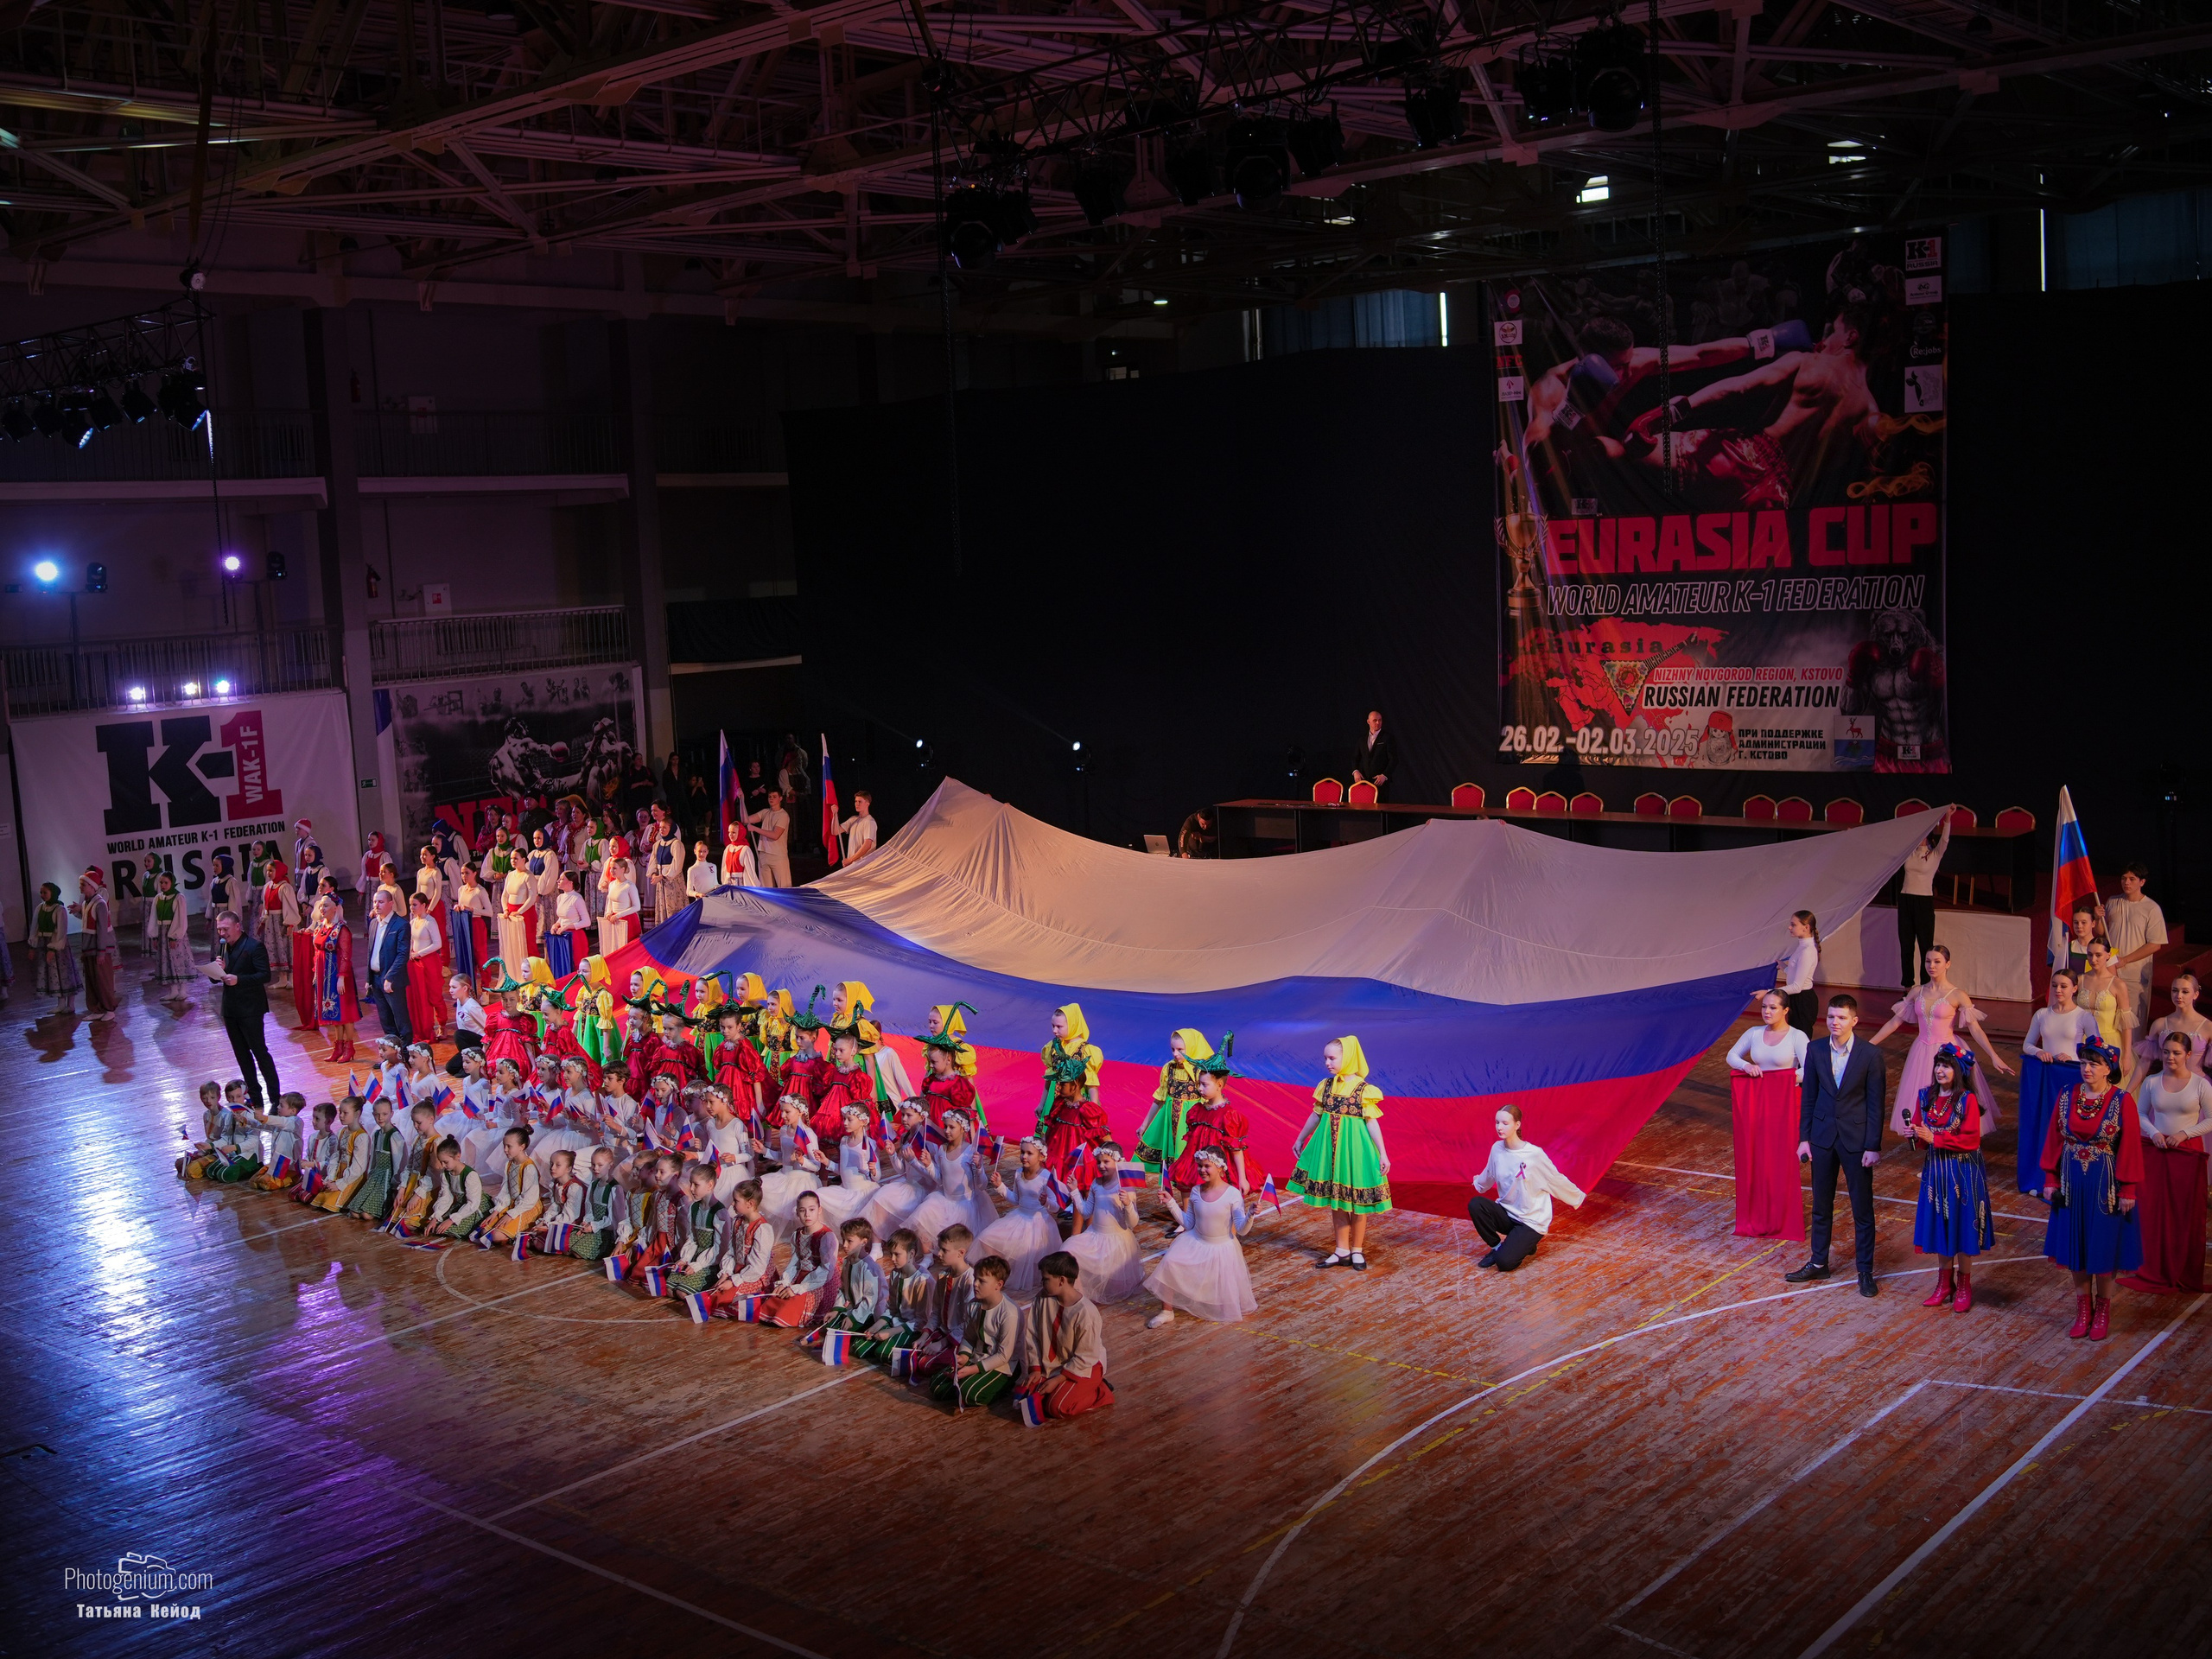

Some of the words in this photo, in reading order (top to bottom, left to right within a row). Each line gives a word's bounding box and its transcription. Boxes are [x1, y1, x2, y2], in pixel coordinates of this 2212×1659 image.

[1907, 239, 1937, 259] K-1
[1906, 260, 1938, 269] RUSSIA
[1547, 510, 1792, 575] EURASIA
[1808, 503, 1937, 567] CUP
[1548, 584, 1621, 616] WORLD
[1621, 581, 1732, 614] AMATEUR
[1732, 579, 1775, 613] K-1
[1776, 575, 1926, 612] FEDERATION
[1655, 668, 1694, 681] NIZHNY
[1695, 668, 1753, 681] NOVGOROD
[1755, 668, 1797, 683] REGION,
[1800, 668, 1843, 681] KSTOVO
[1644, 686, 1721, 707] RUSSIAN
[1726, 685, 1840, 708] FEDERATION
[1738, 729, 1758, 738] ПРИ
[1761, 729, 1823, 739] ПОДДЕРЖКЕ
[1738, 740, 1826, 750] АДМИНИСТРАЦИИ
[1750, 751, 1788, 760] КСТОВО
[95, 710, 284, 836] K-1
[239, 725, 264, 804] WAK-1F
[107, 838, 145, 855] WORLD
[149, 830, 199, 849] AMATEUR
[201, 830, 219, 842] K-1
[224, 820, 286, 840] FEDERATION
